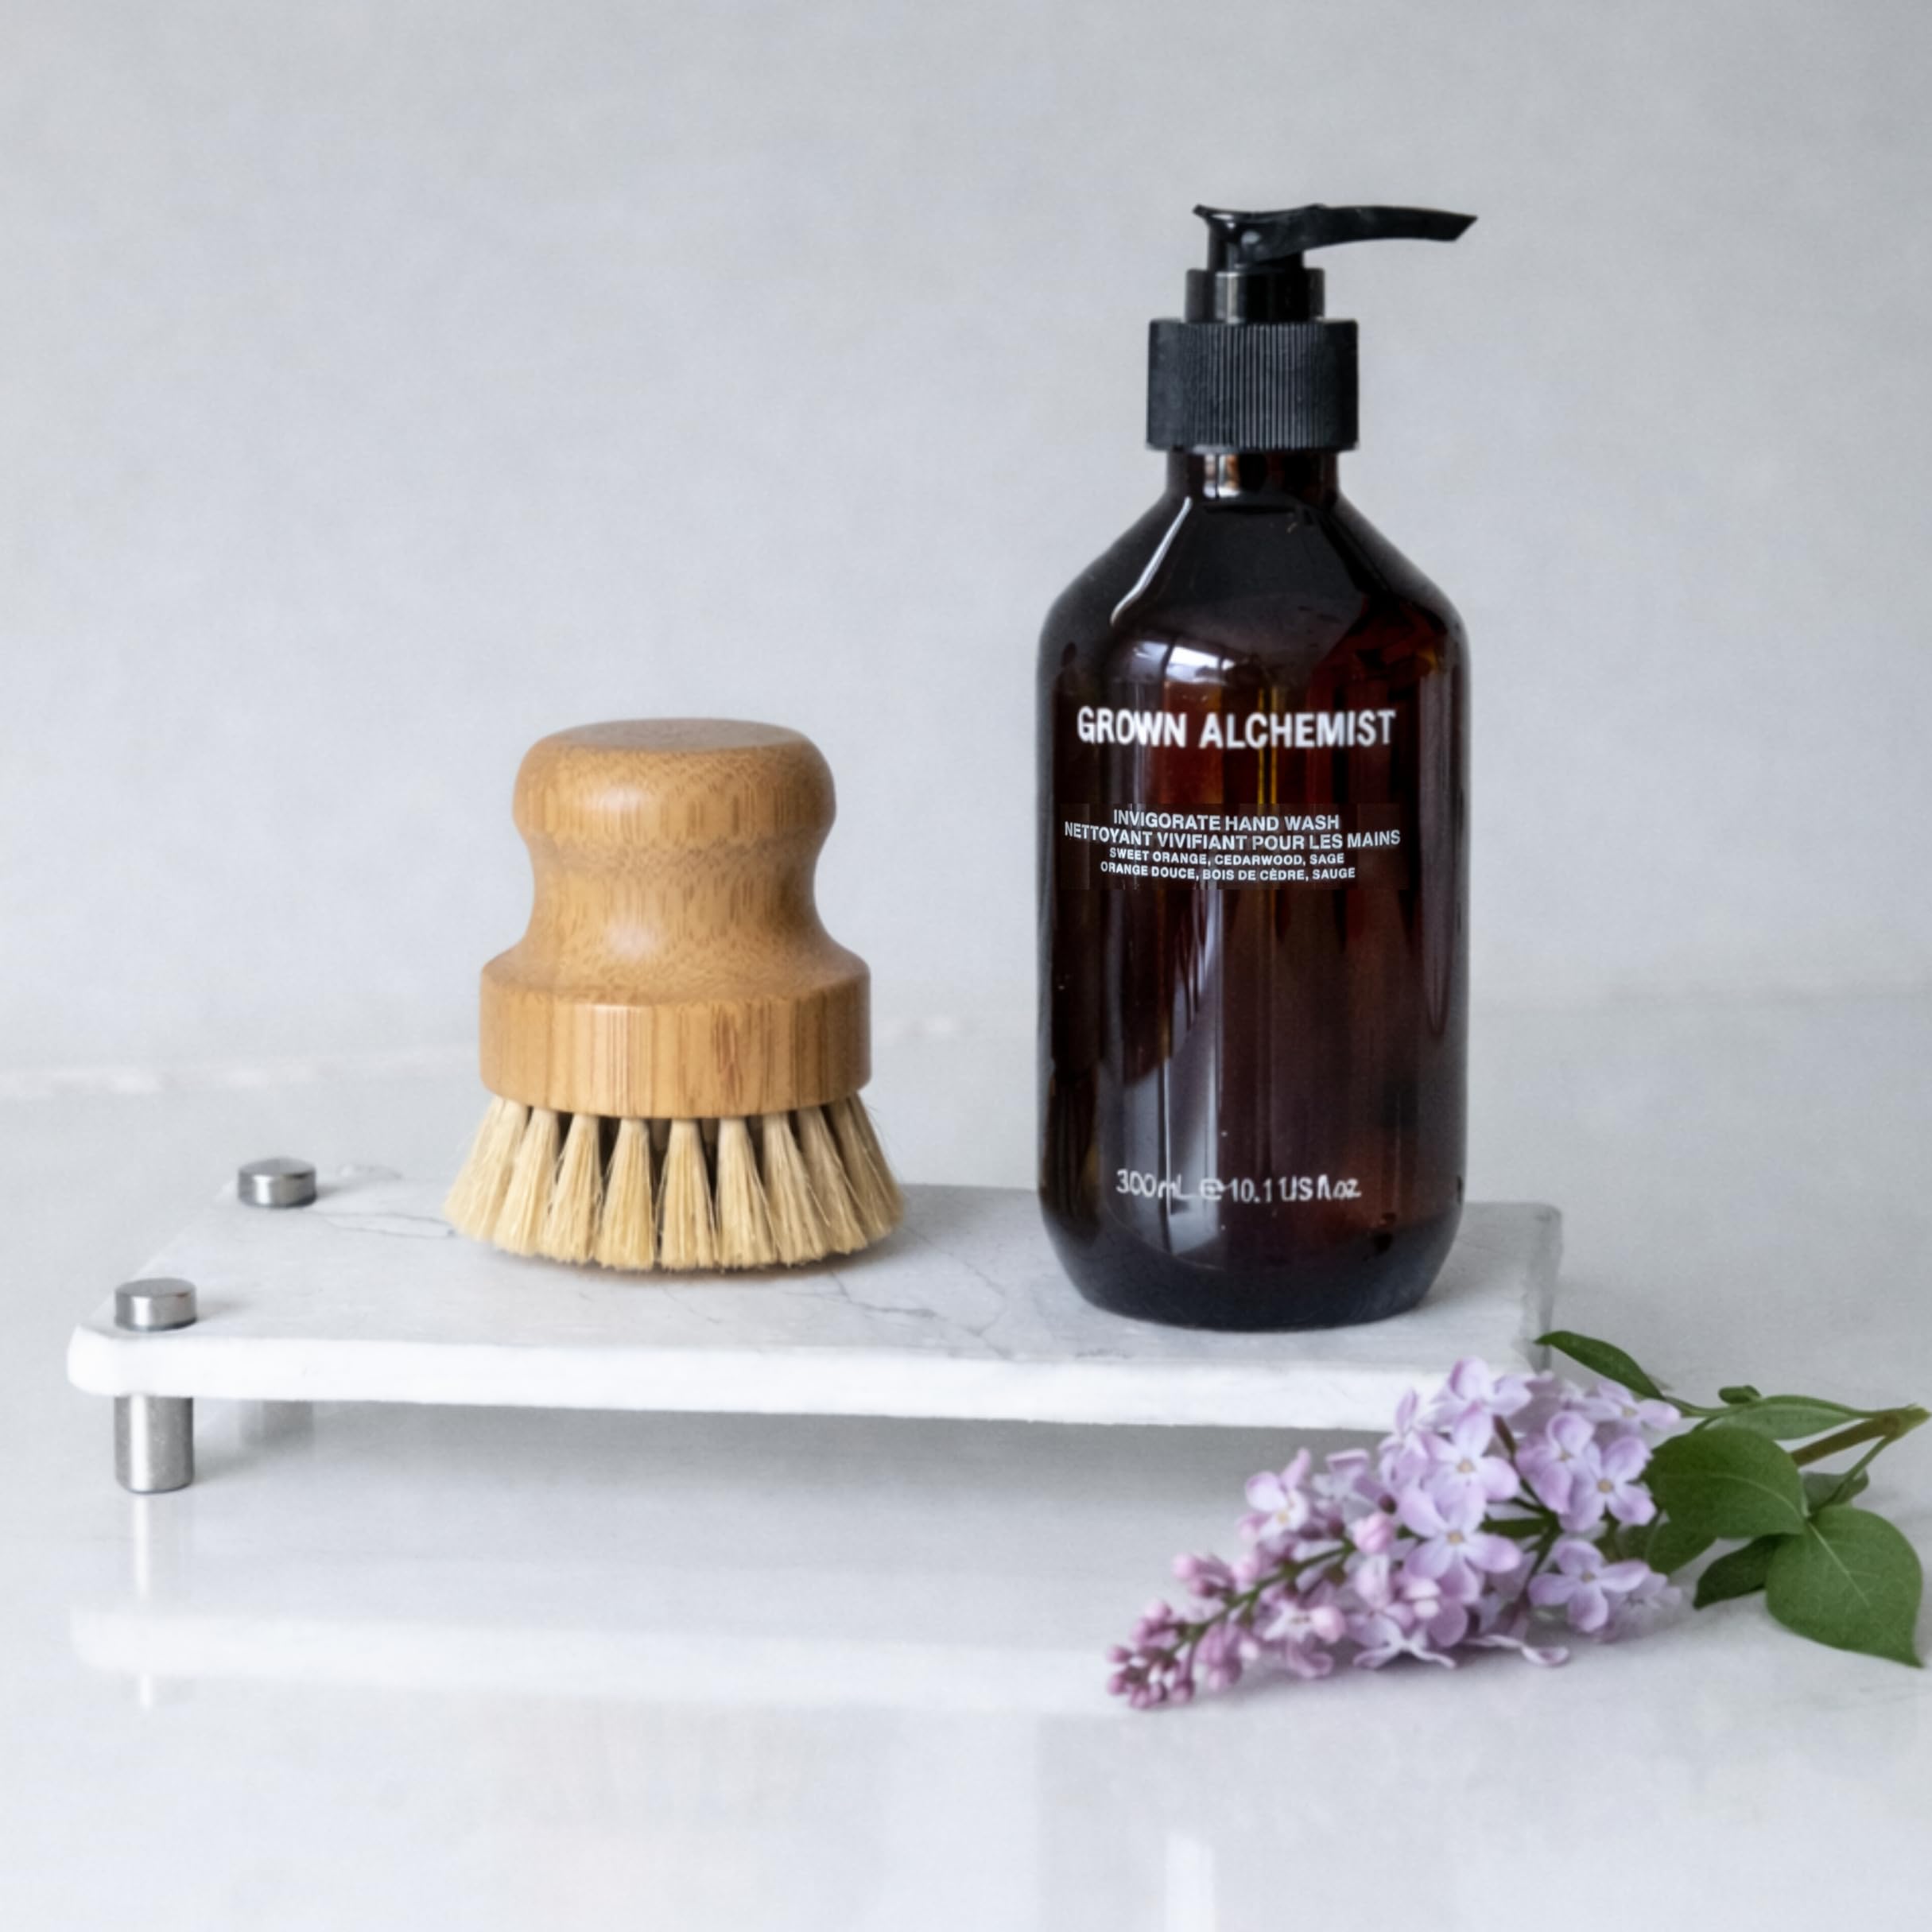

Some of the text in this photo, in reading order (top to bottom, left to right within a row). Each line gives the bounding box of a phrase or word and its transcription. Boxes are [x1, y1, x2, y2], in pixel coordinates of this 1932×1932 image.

[1077, 706, 1396, 749] GROWN ALCHEMIST
[1113, 809, 1340, 832] INVIGORATE HAND WASH
[1065, 821, 1401, 851] NETTOYANT VIVIFIANT POUR LES MAINS
[1109, 848, 1344, 867] SWEET ORANGE, CEDARWOOD, SAGE
[1100, 861, 1356, 882] ORANGE DOUCE, BOIS DE CÈDRE, SAUGE
[1231, 1177, 1272, 1203] 10.1
